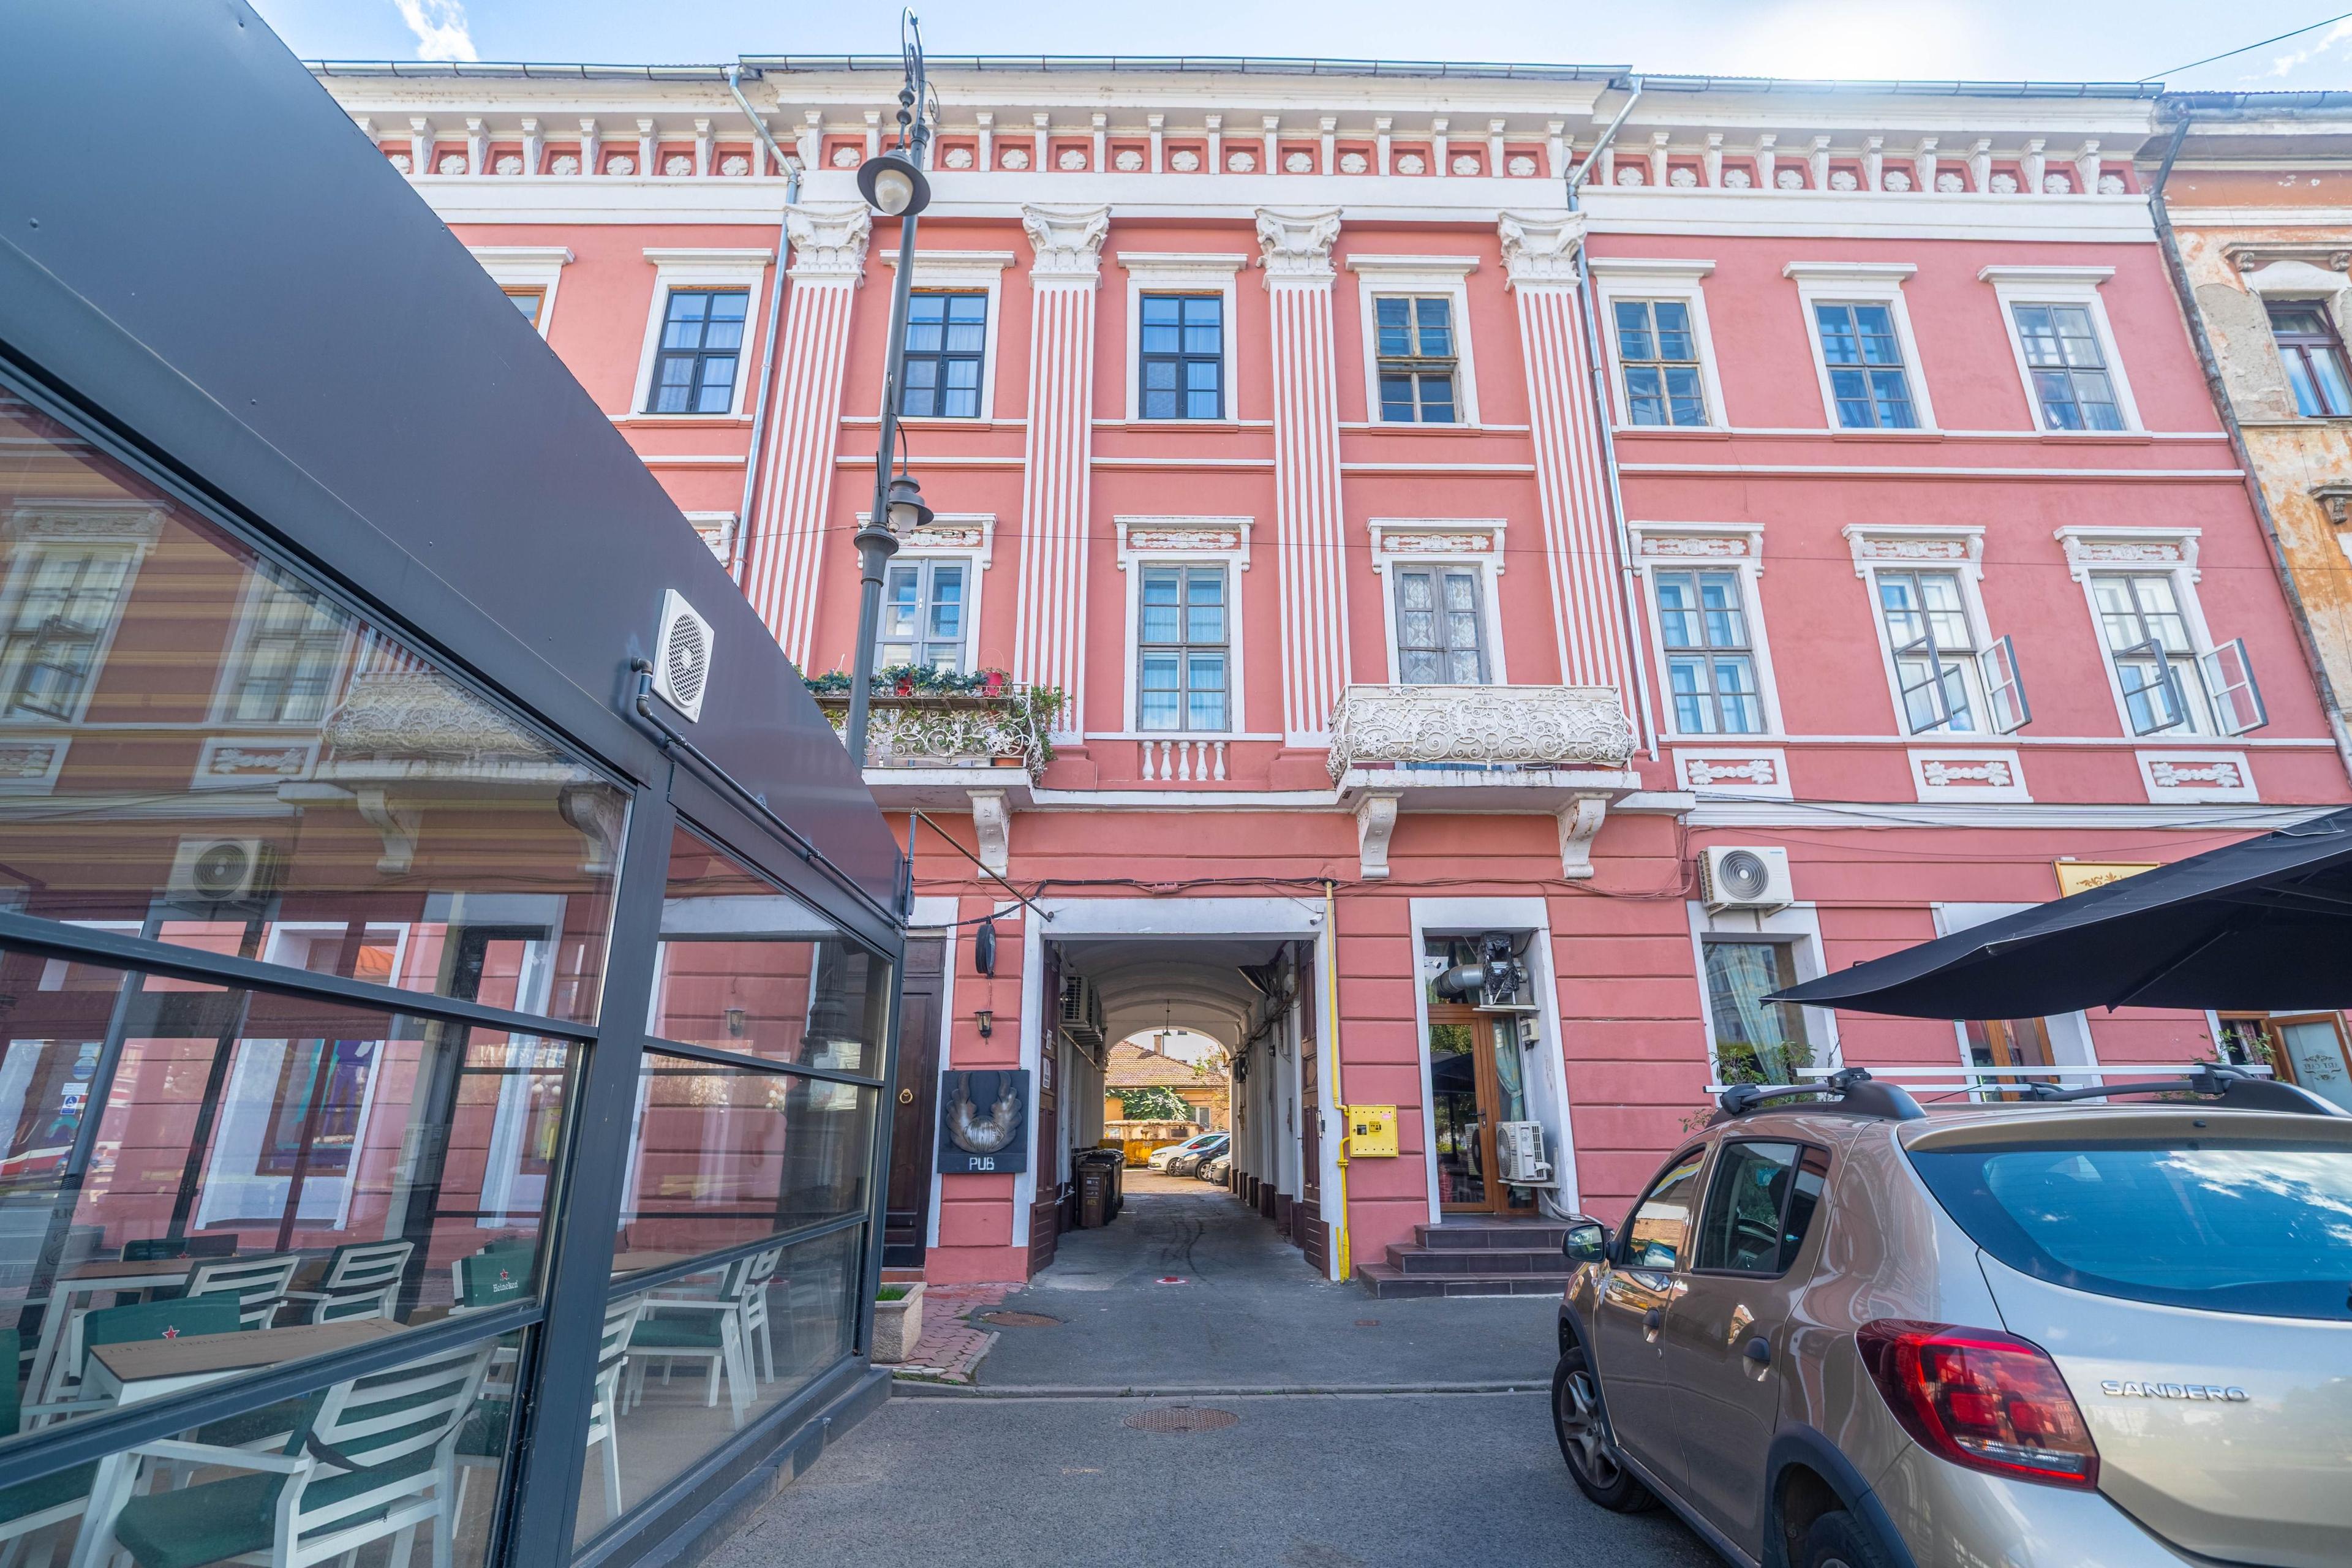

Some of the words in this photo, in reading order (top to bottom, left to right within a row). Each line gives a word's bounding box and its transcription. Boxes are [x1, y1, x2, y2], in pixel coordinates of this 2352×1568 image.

[969, 1157, 995, 1170] PUB
[492, 1281, 518, 1292] Heineken
[2101, 1380, 2250, 1402] SANDERO
